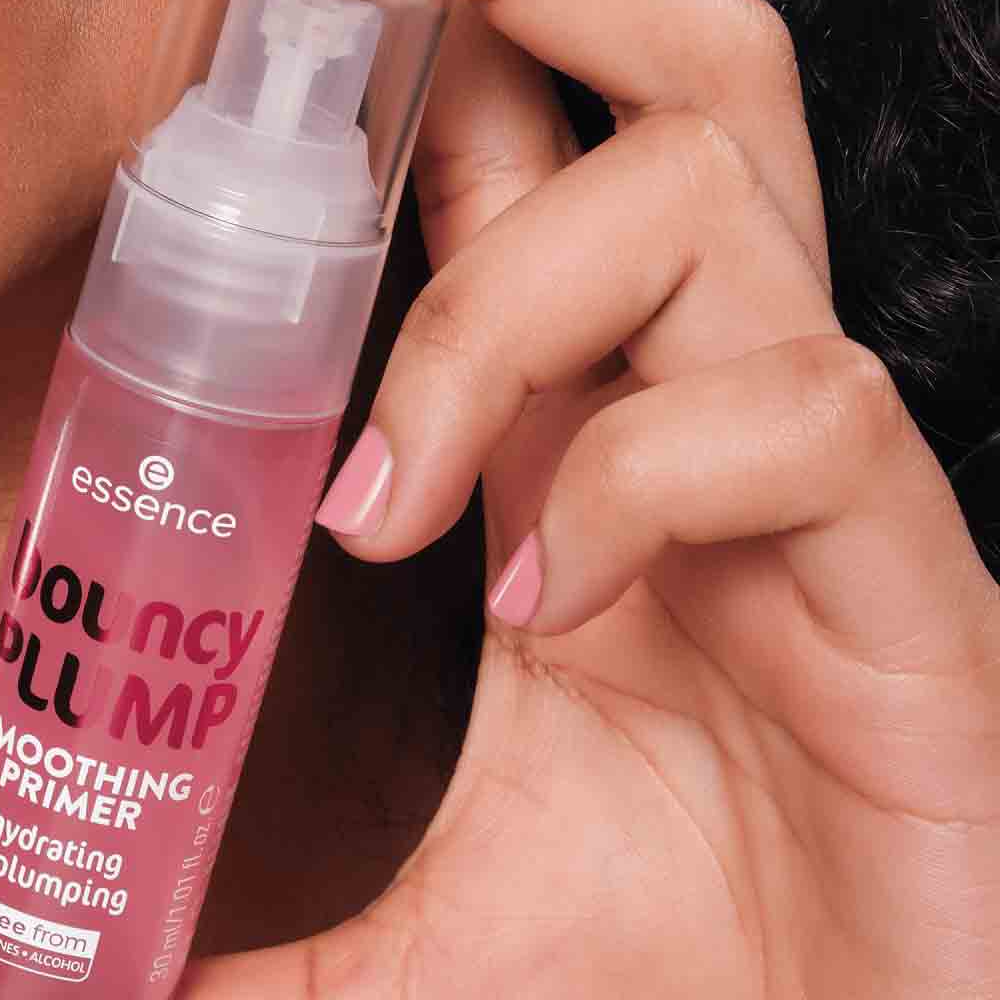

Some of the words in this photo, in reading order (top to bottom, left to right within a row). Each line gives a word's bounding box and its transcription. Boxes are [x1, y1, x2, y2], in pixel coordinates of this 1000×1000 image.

[72, 466, 237, 538] essence
[0, 758, 142, 831] PRIMER
[30, 951, 87, 974] ALCOHOL
[32, 924, 88, 953] from
